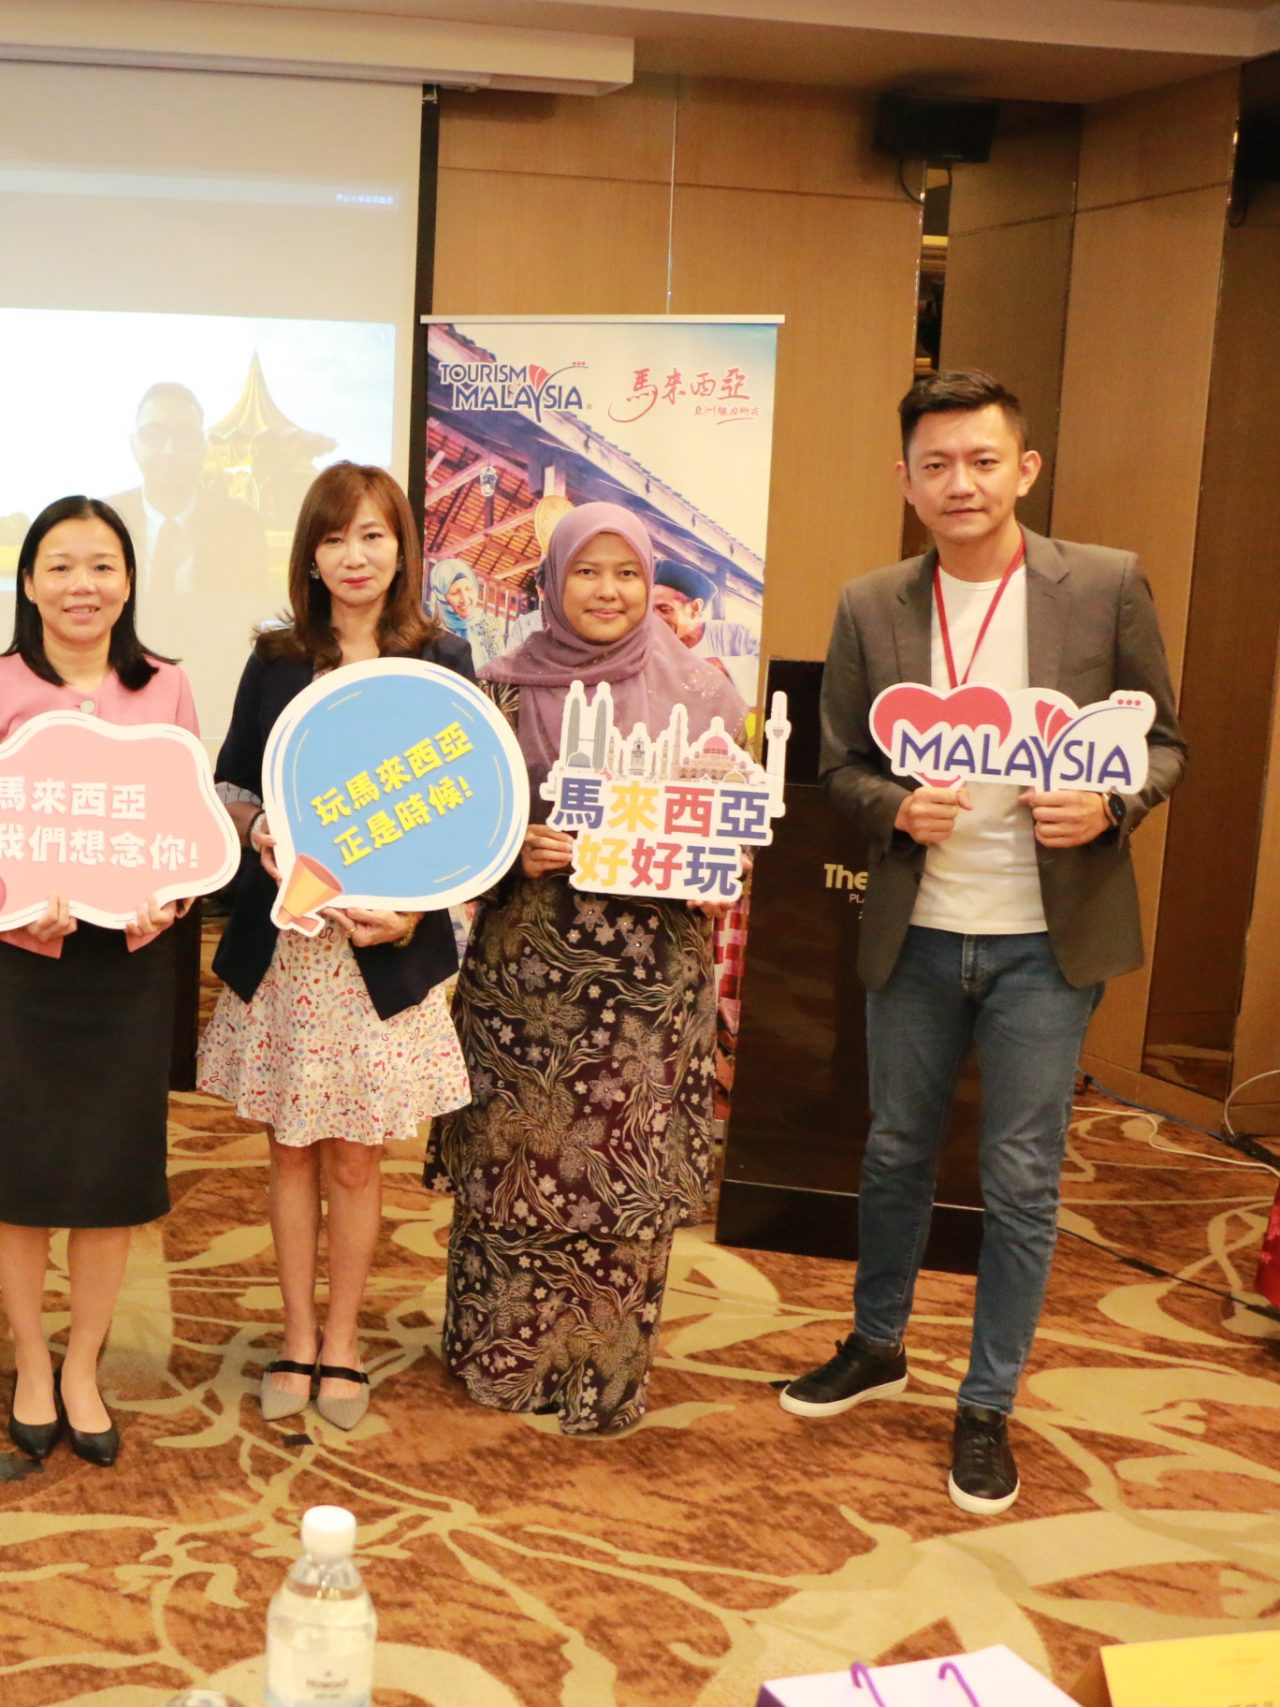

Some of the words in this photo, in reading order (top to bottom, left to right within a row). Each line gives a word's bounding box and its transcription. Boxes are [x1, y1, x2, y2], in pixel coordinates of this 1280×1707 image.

[439, 362, 528, 386] TOURISM
[452, 384, 584, 423] MALAYSIA
[311, 721, 474, 827] 玩馬來西亞
[899, 727, 1132, 793] MALAYSIA
[553, 777, 770, 840] 馬來西亞
[576, 834, 738, 897] 好好玩
[823, 863, 869, 891] The
